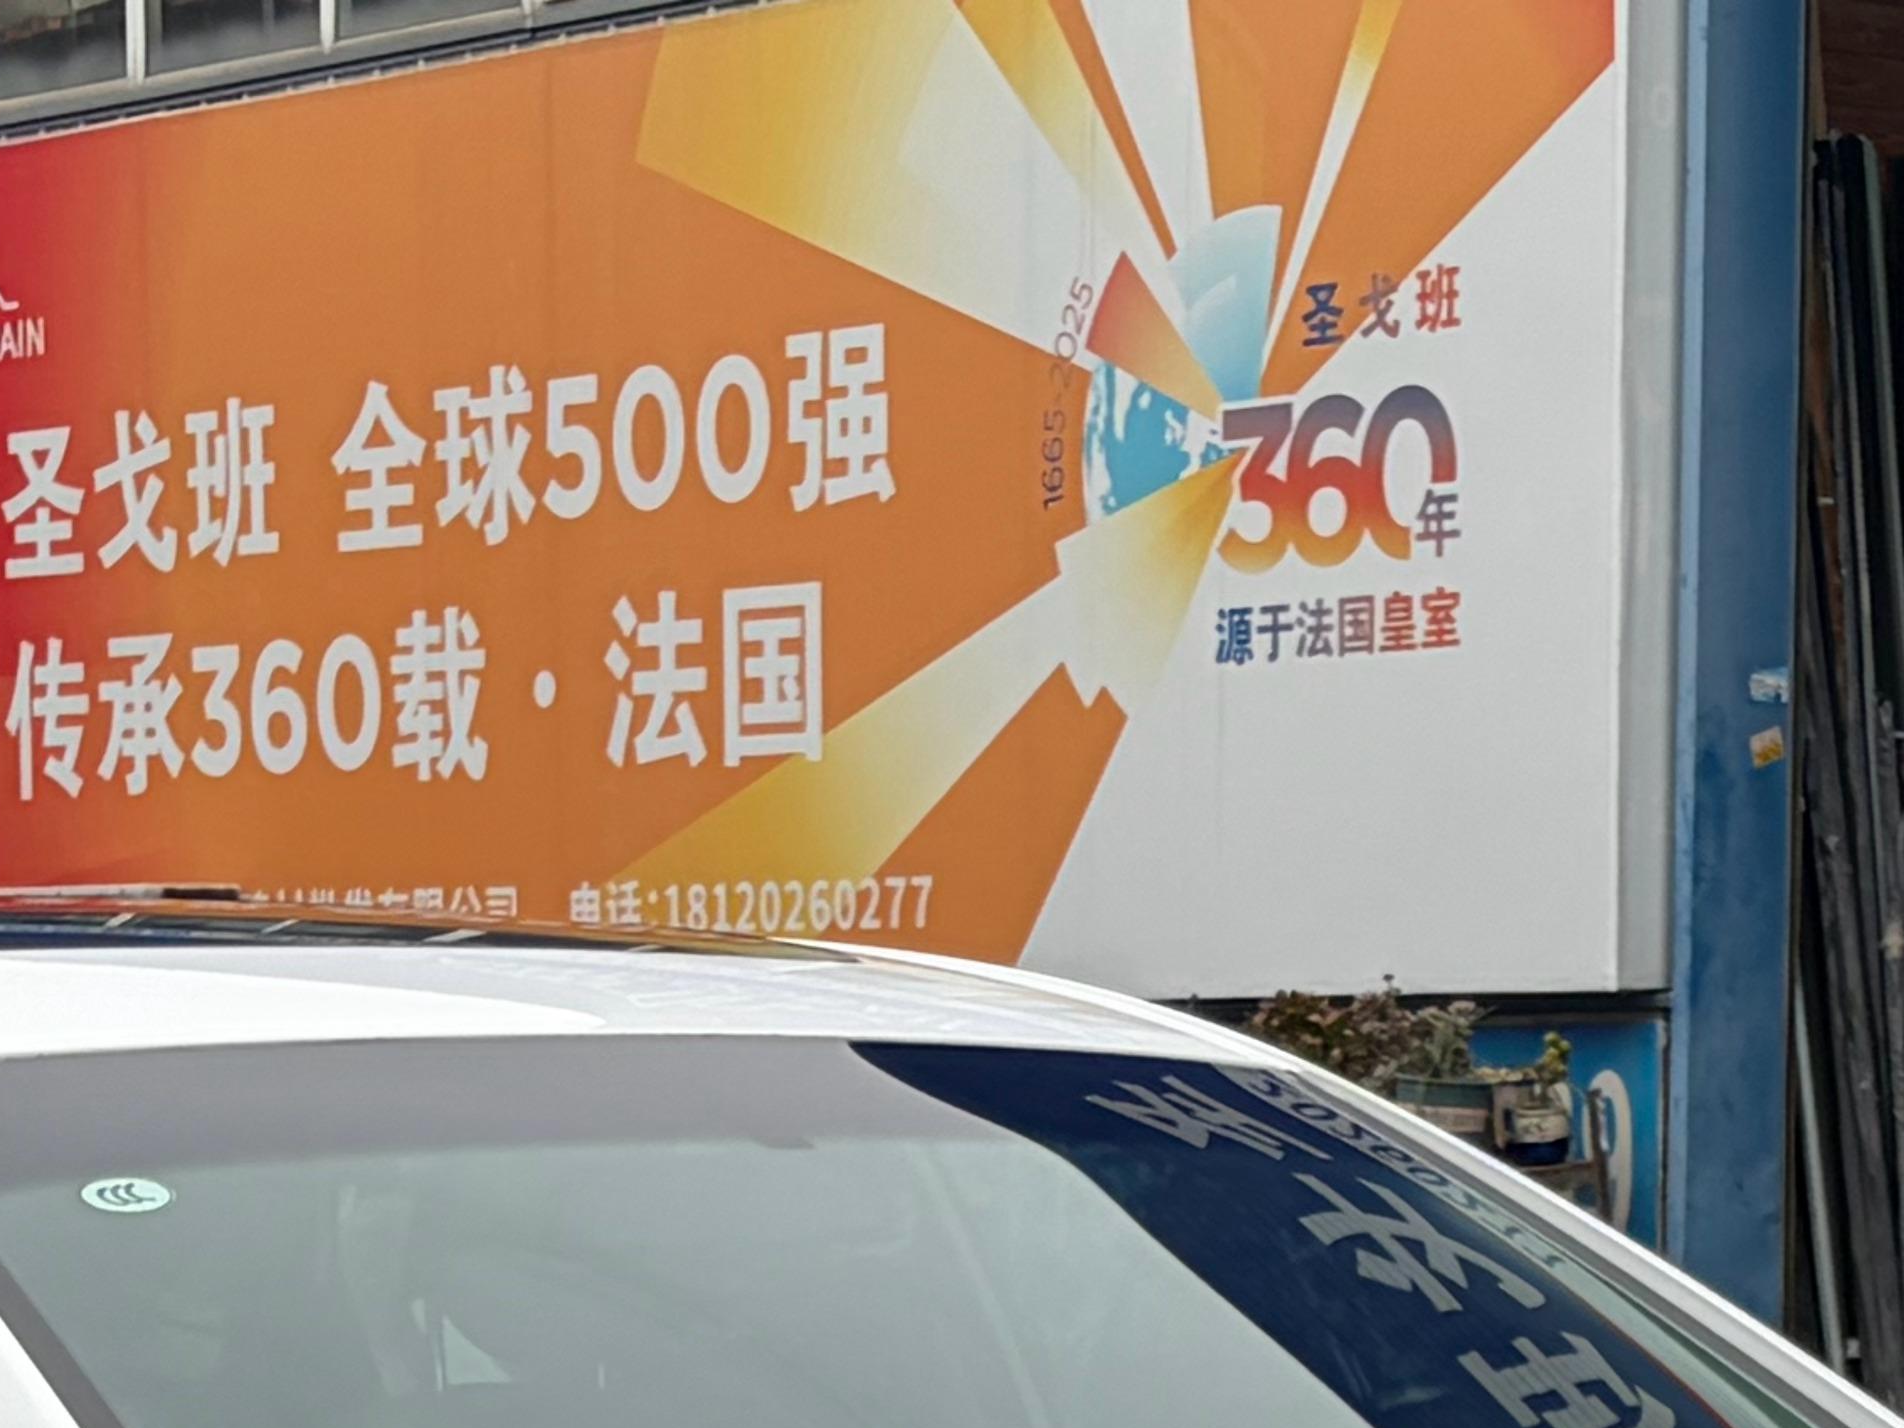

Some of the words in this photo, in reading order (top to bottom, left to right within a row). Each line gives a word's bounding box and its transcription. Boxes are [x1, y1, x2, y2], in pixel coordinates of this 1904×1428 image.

[1040, 275, 1095, 512] 1665-2025
[1301, 263, 1463, 348] 圣戈班
[1, 396, 281, 581] 圣戈班
[331, 321, 896, 553] 全球500强
[1216, 384, 1463, 576] 360年
[1214, 587, 1463, 666] 源于法国皇室
